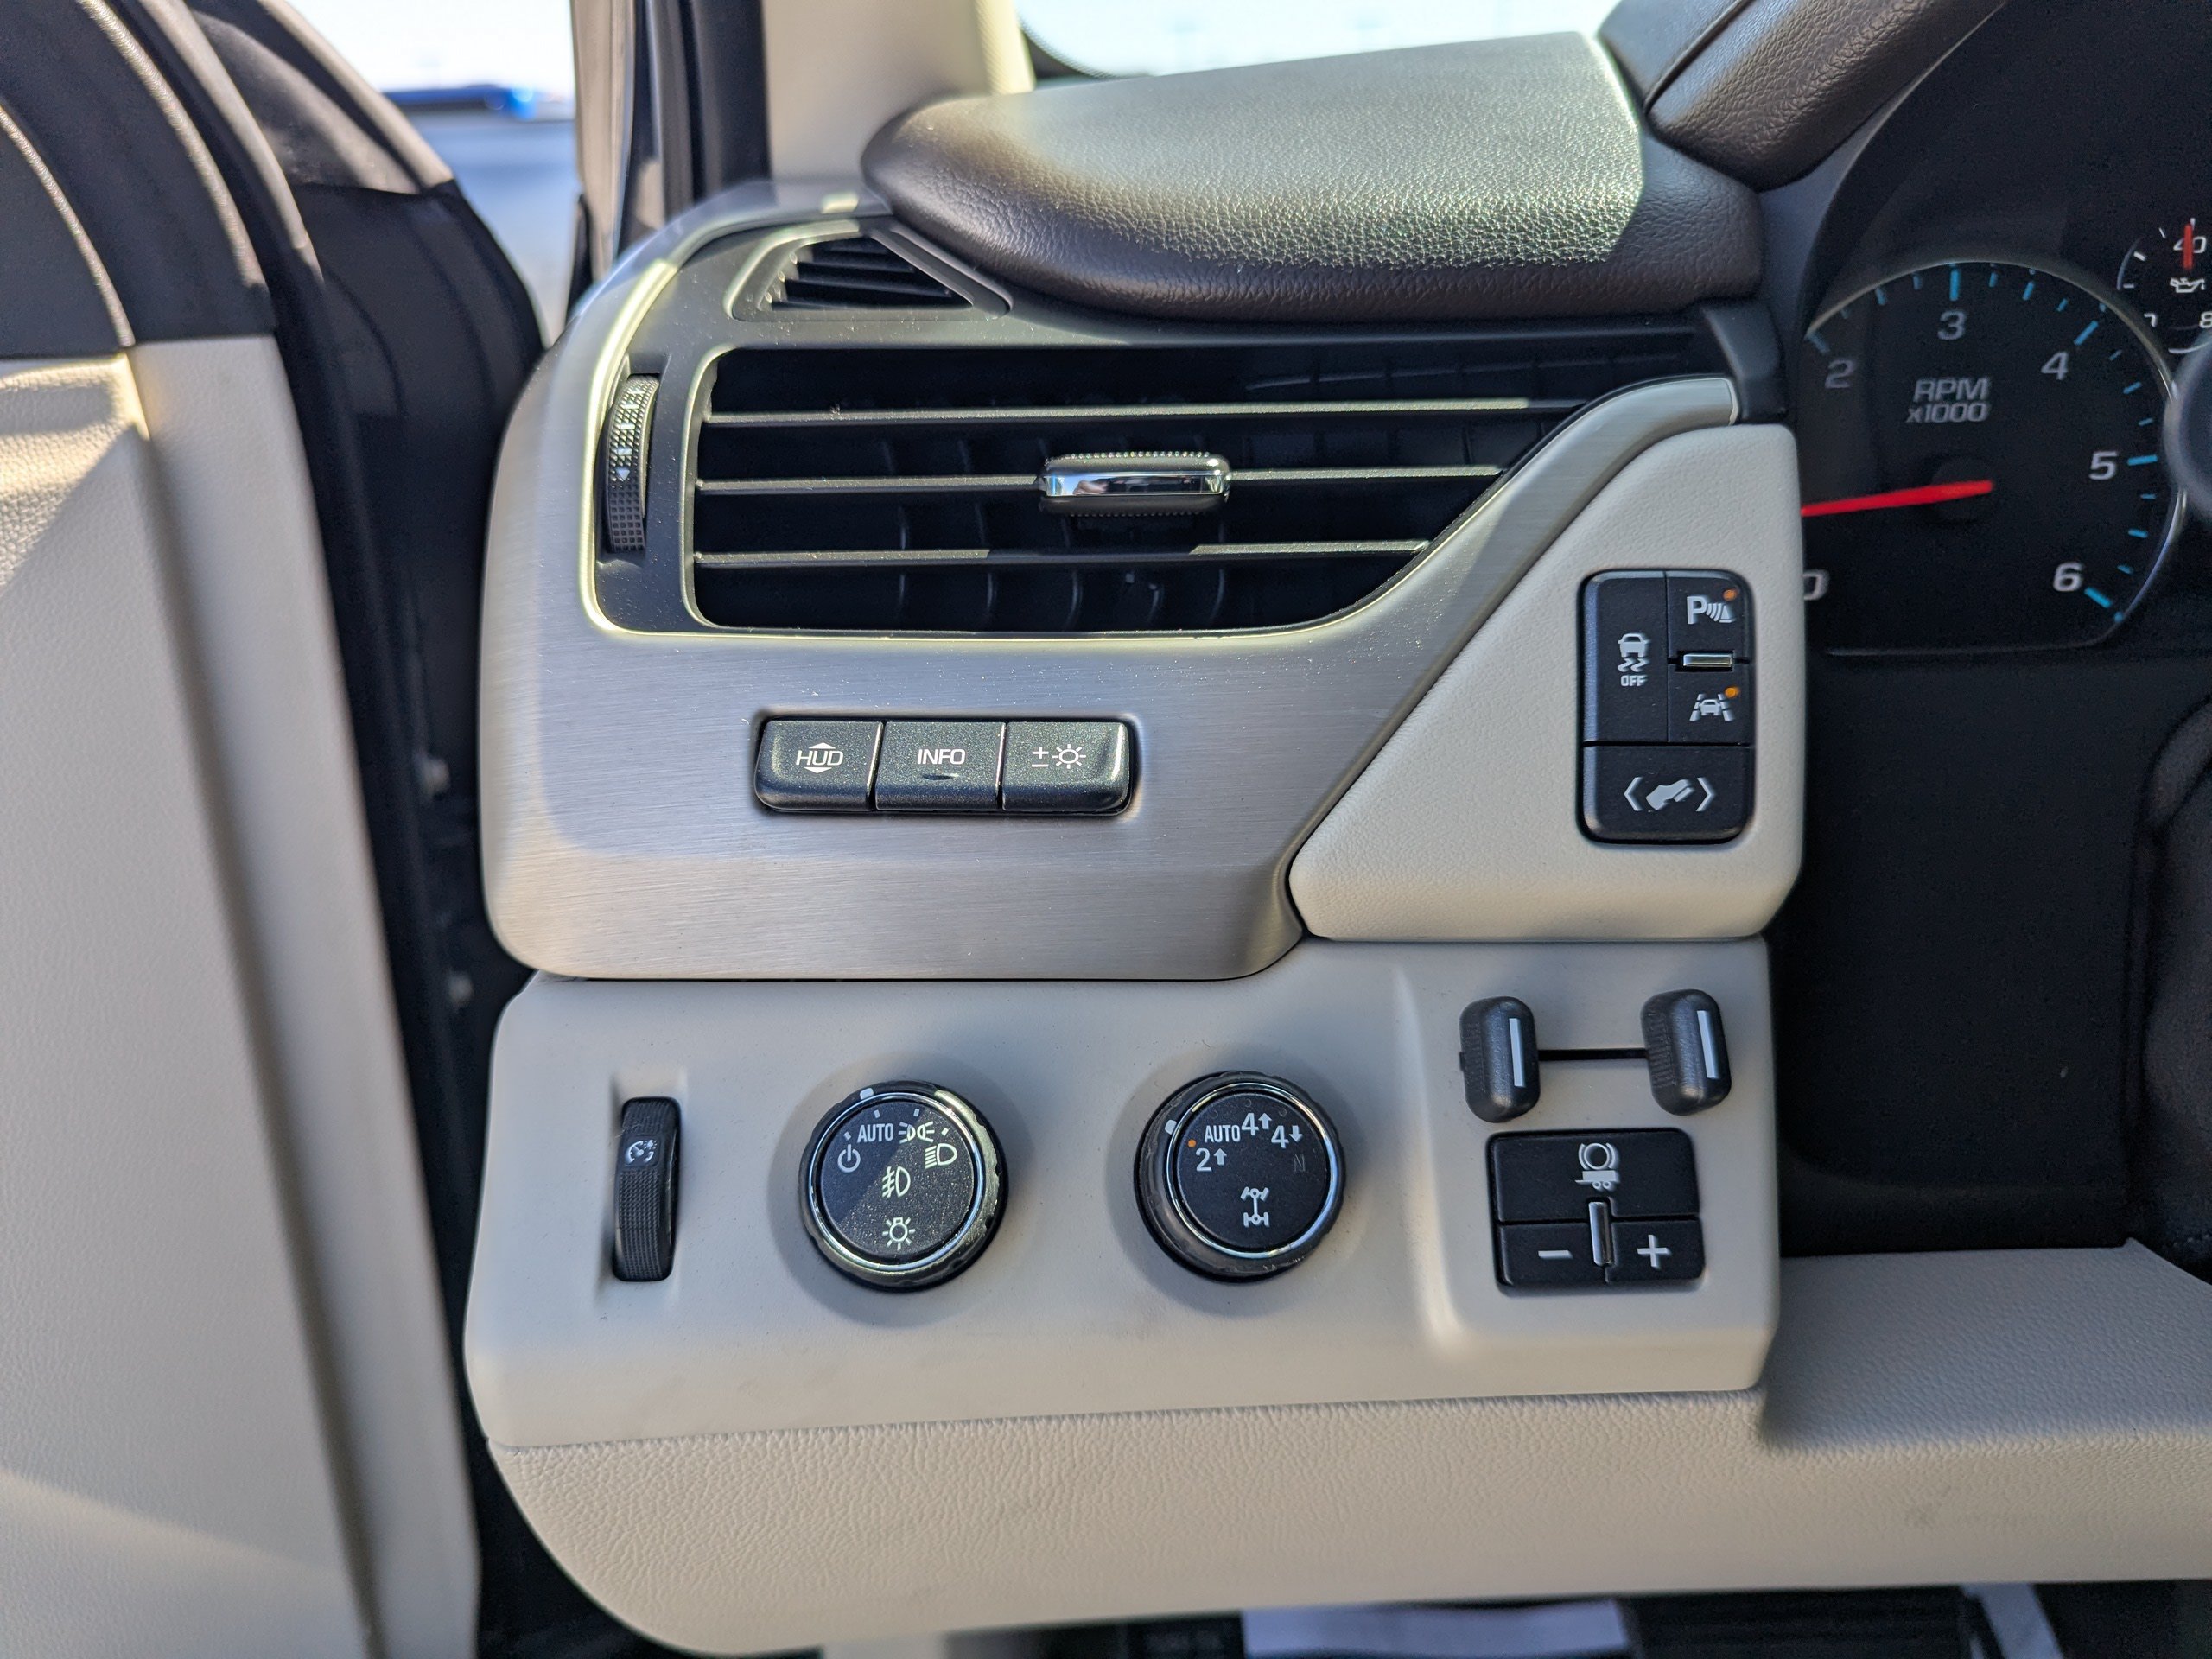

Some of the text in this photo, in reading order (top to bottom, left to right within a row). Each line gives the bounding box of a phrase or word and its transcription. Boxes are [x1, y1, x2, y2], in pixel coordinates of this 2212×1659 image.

[1937, 311, 1967, 340] 3
[1825, 359, 1855, 389] 2
[2041, 352, 2069, 380] 4
[1913, 378, 1988, 401] RPM
[1906, 403, 1988, 423] x1000
[2088, 451, 2119, 480] 5
[2053, 563, 2084, 592] 6
[1687, 595, 1707, 624] P
[1620, 675, 1647, 686] OFF
[796, 750, 843, 766] HUD
[917, 748, 966, 765] INFO
[857, 1123, 894, 1142] AUTO
[1204, 1124, 1241, 1143] AUTO
[1241, 1112, 1259, 1136] 4
[1271, 1125, 1289, 1149] 4
[1195, 1147, 1212, 1172] 2
